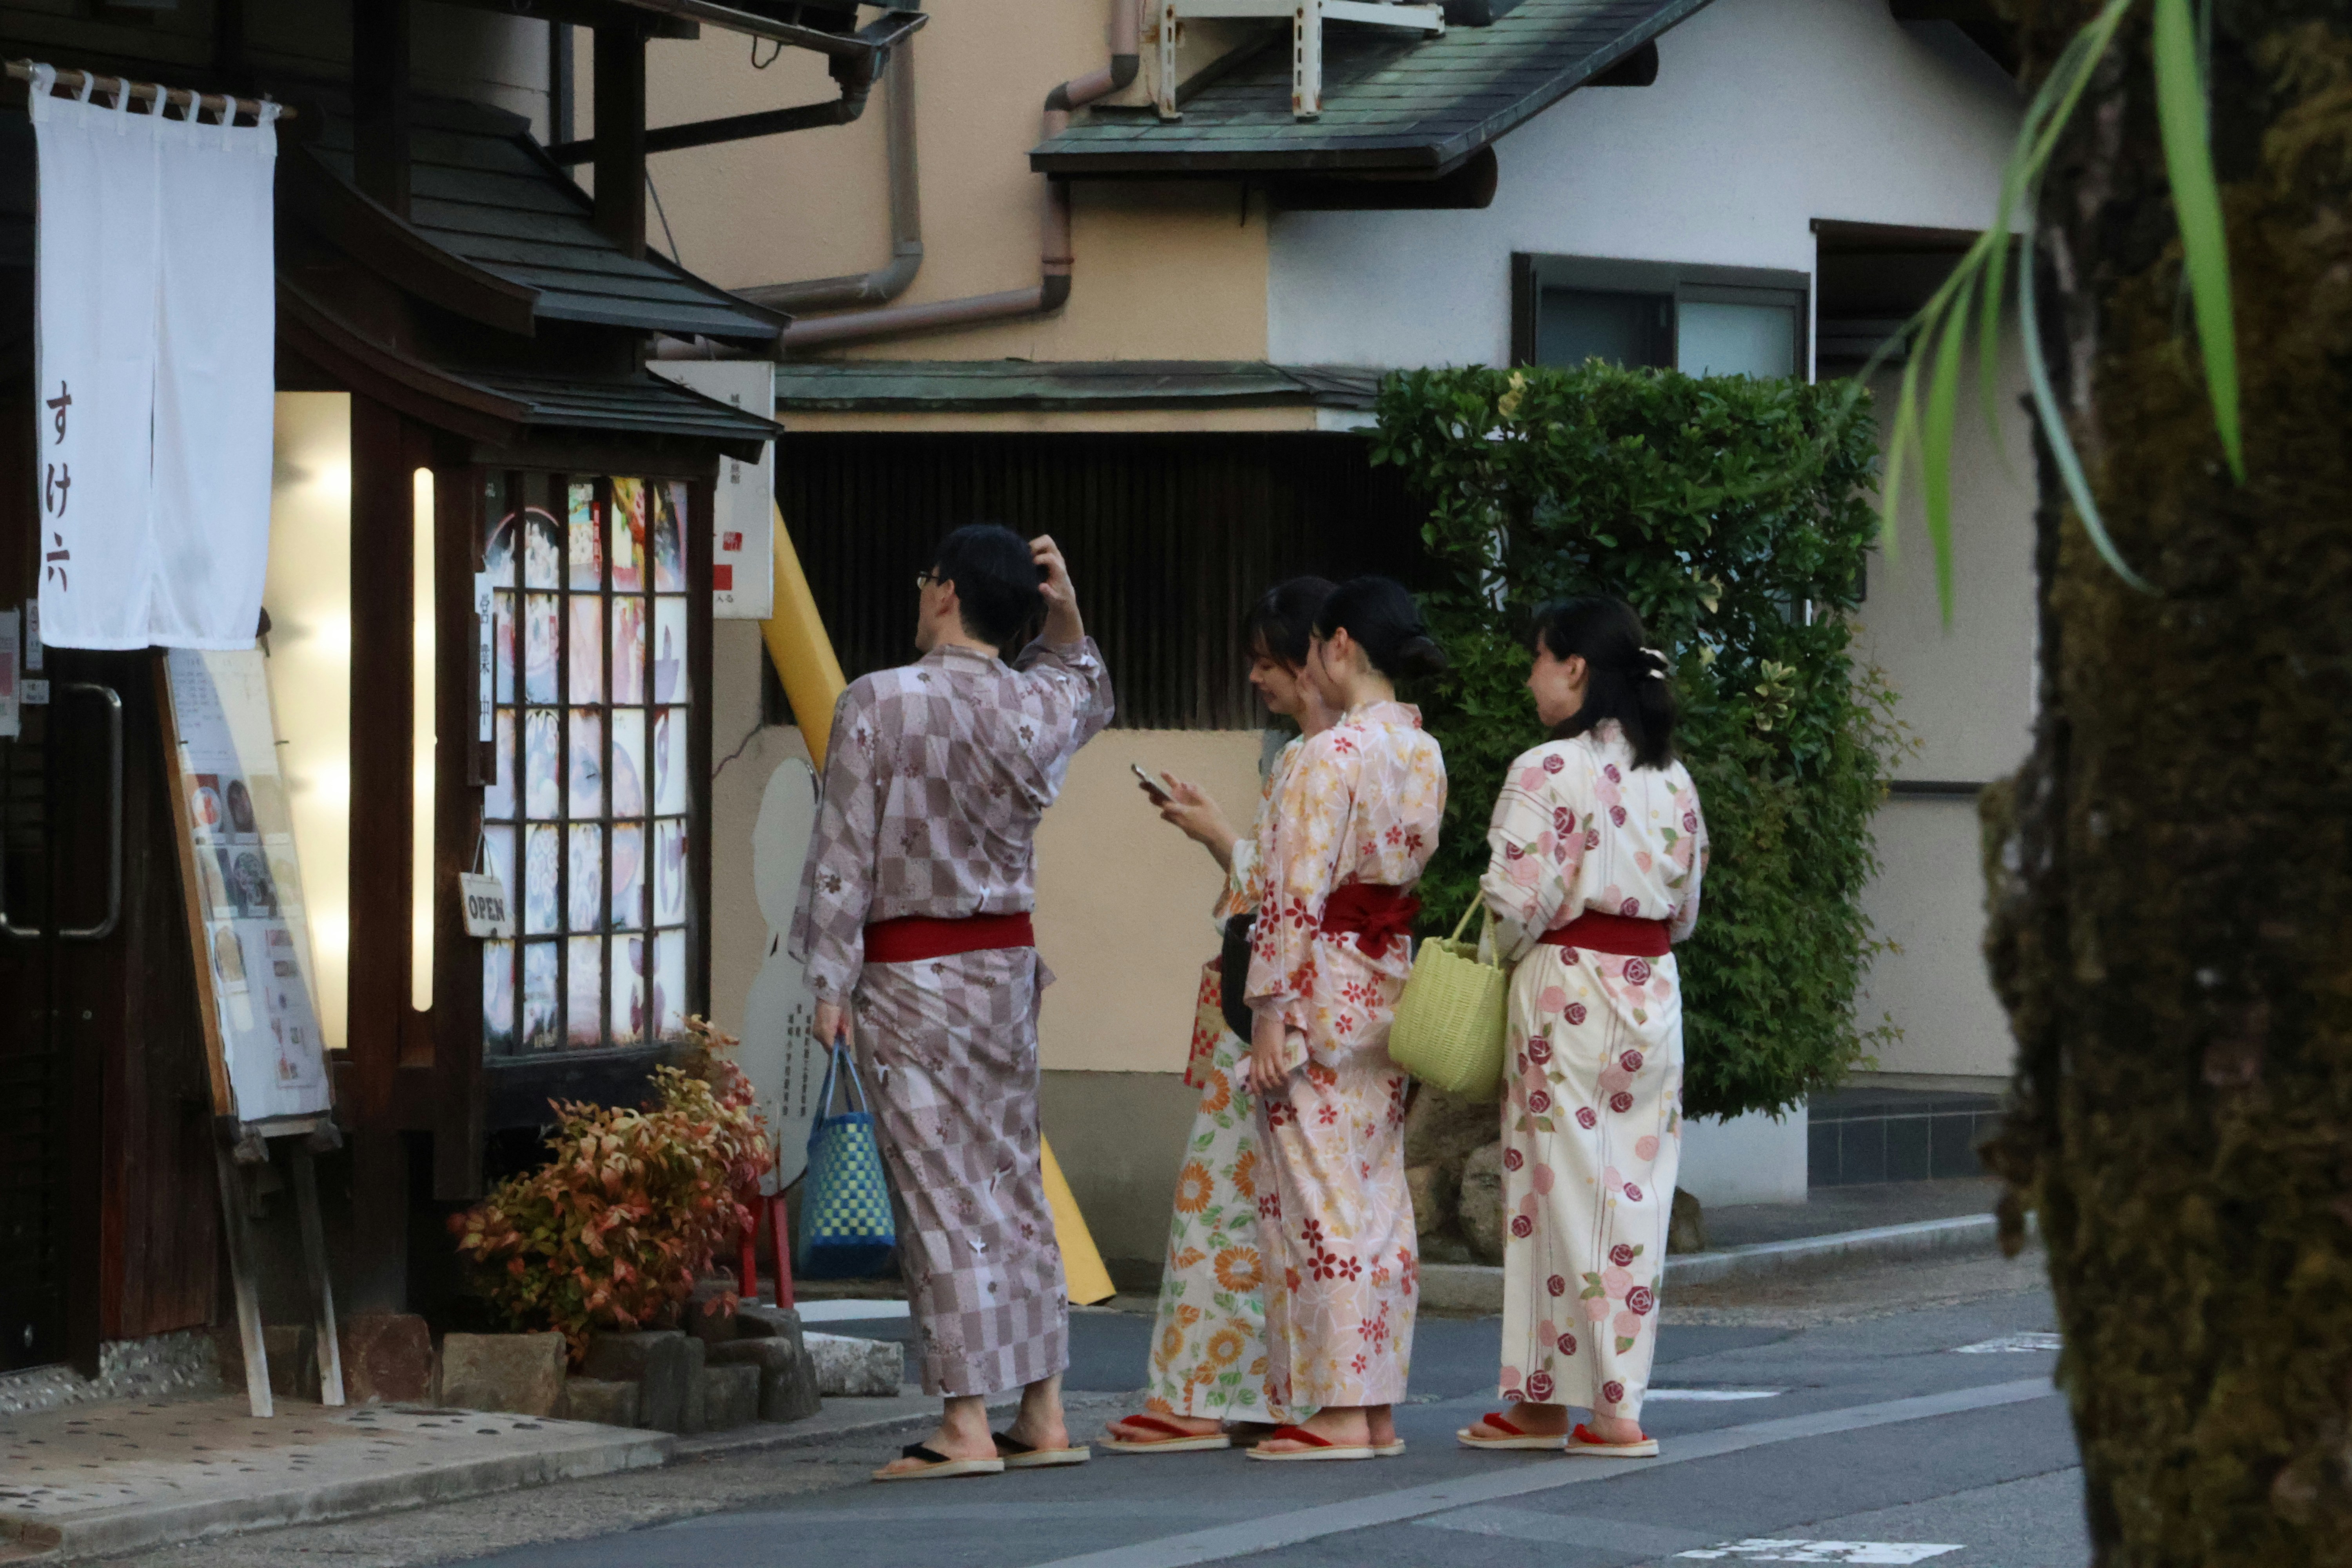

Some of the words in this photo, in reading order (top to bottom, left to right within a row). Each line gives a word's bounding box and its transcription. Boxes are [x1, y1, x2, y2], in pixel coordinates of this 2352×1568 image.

[46, 380, 71, 592] すけ六
[469, 895, 505, 922] OPEN
